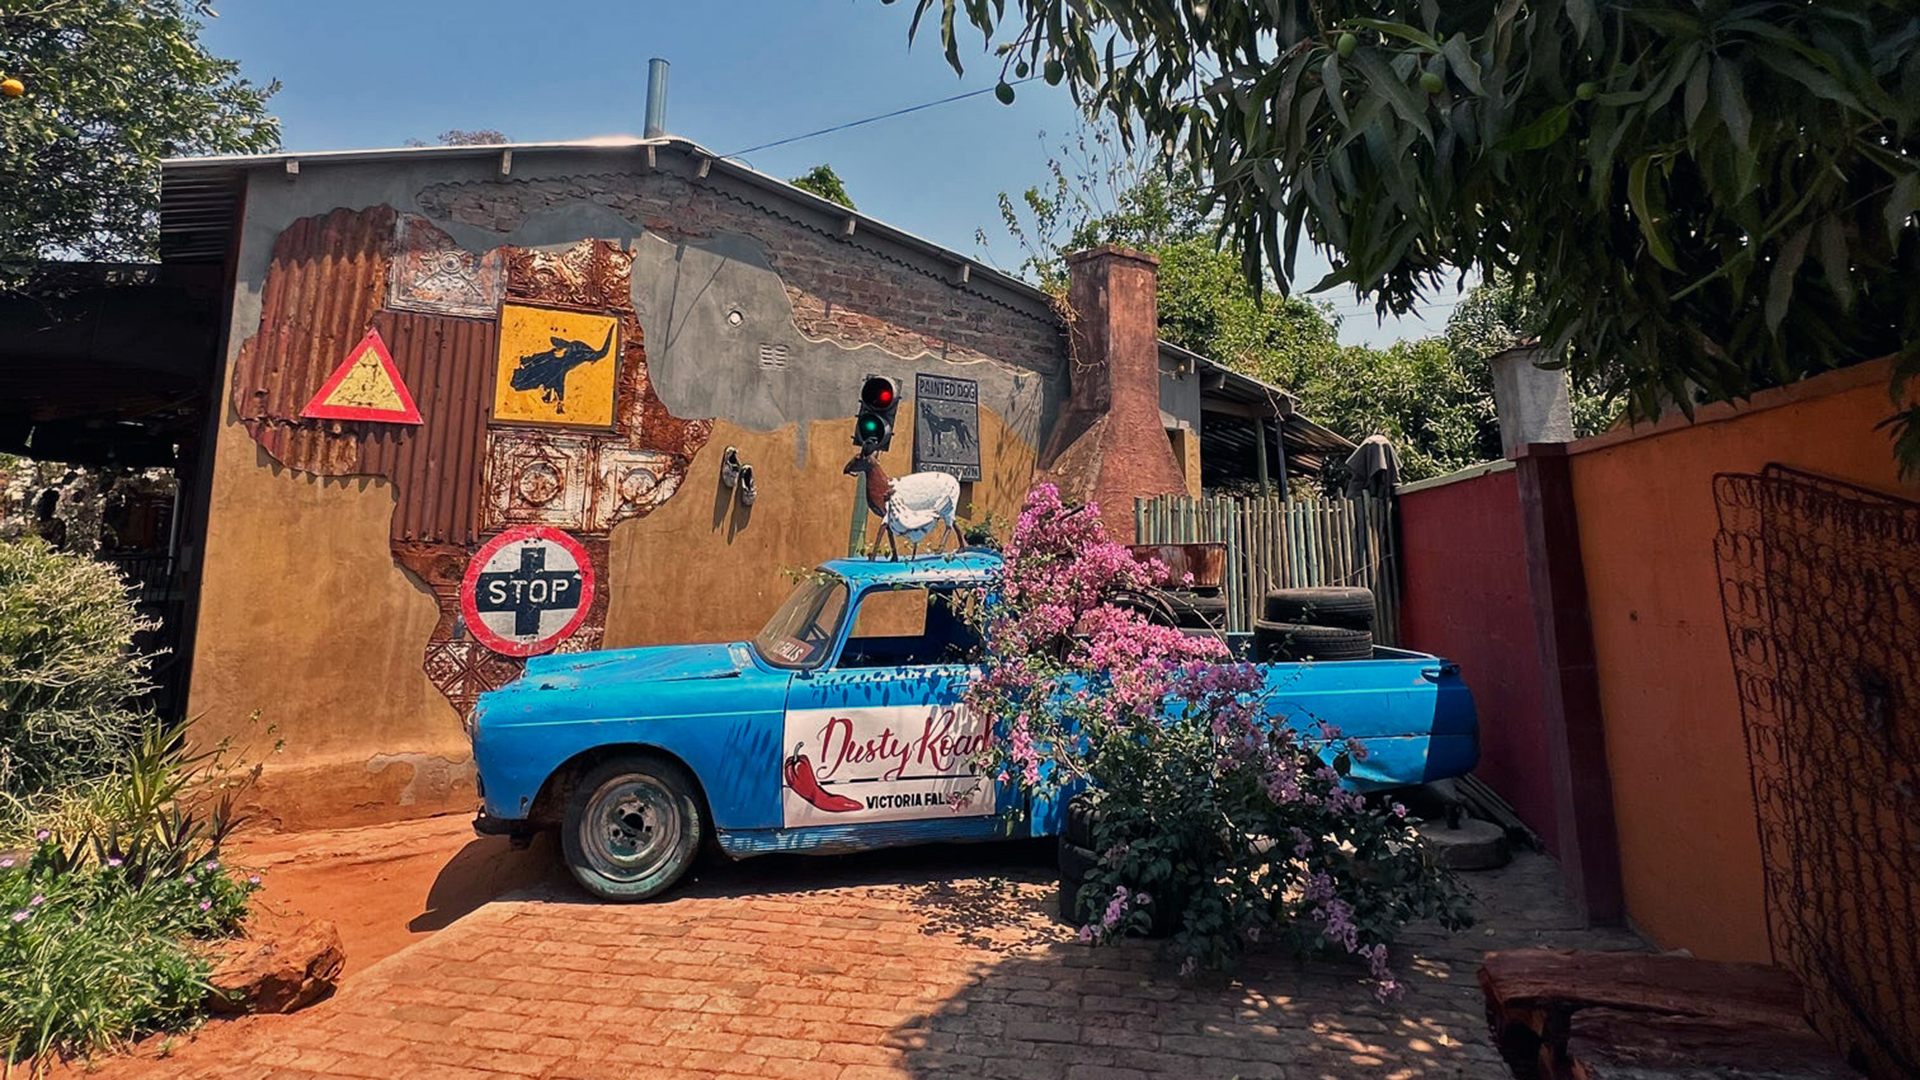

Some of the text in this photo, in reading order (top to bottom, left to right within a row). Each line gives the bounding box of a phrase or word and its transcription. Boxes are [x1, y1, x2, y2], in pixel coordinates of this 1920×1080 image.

[919, 379, 975, 399] PAINTED DOG
[488, 579, 569, 604] STOP
[816, 710, 994, 781] Dusty Road
[866, 794, 922, 809] VICTORIA
